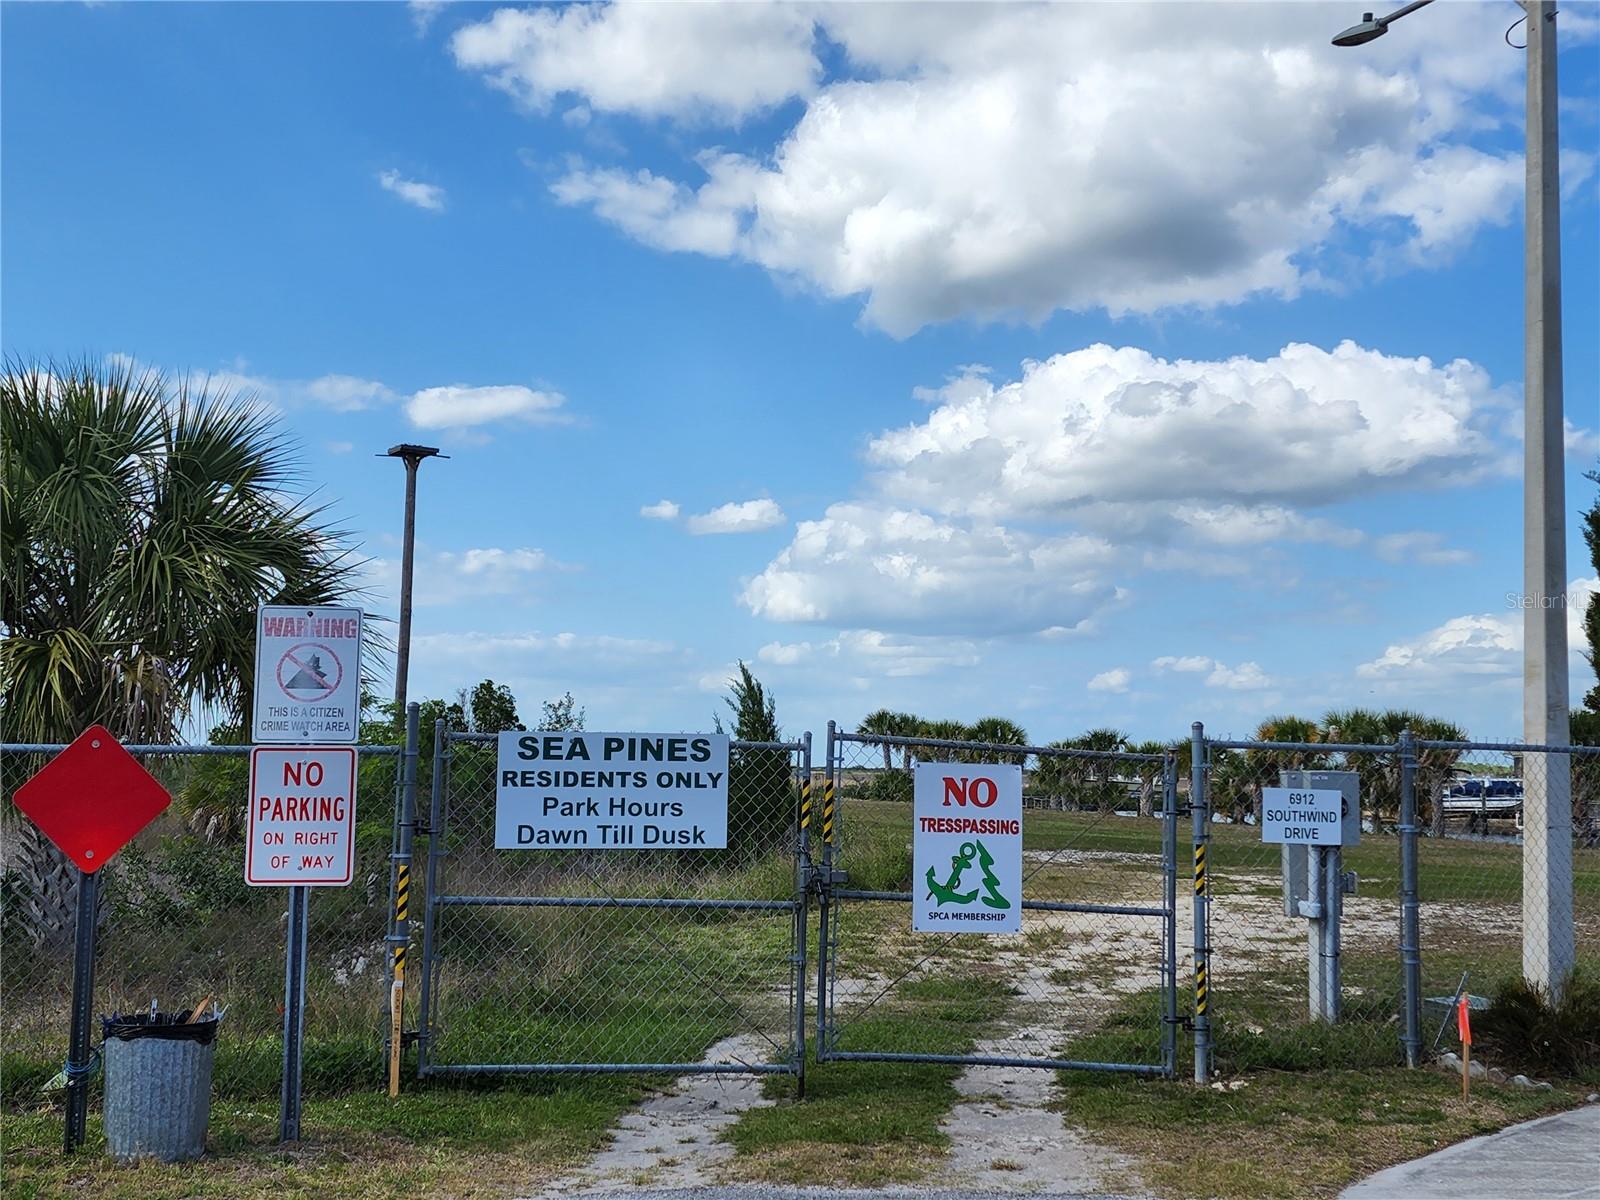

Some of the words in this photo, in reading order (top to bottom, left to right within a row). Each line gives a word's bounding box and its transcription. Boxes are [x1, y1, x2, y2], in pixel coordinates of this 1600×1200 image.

[264, 617, 357, 638] WARNING
[269, 707, 288, 717] THIS
[291, 707, 299, 717] IS
[301, 707, 307, 717] A
[310, 707, 344, 718] CITIZEN
[261, 721, 289, 731] CRIME
[292, 721, 322, 731] WATCH
[325, 721, 350, 732] AREA
[517, 736, 590, 761] SEA
[603, 737, 711, 762] PINES
[283, 761, 324, 787] NO
[502, 770, 647, 788] RESIDENTS
[656, 772, 723, 789] ONLY
[943, 777, 998, 808] NO
[1289, 793, 1315, 805] 6912
[259, 797, 345, 821] PARKING
[542, 797, 599, 817] Park
[609, 797, 683, 817] Hours
[1267, 810, 1337, 823] SOUTHWIND
[517, 825, 587, 844] Dawn
[597, 825, 633, 844] Till
[643, 825, 706, 844] Dusk
[919, 817, 1020, 835] TRESSPASSING
[1284, 827, 1319, 840] DRIVE
[263, 832, 284, 845] ON
[294, 832, 338, 845] RIGHT
[271, 856, 290, 869] OF
[302, 856, 334, 868] WAY
[928, 912, 950, 920] SPCA
[952, 912, 1006, 921] MEMBERSHIP
